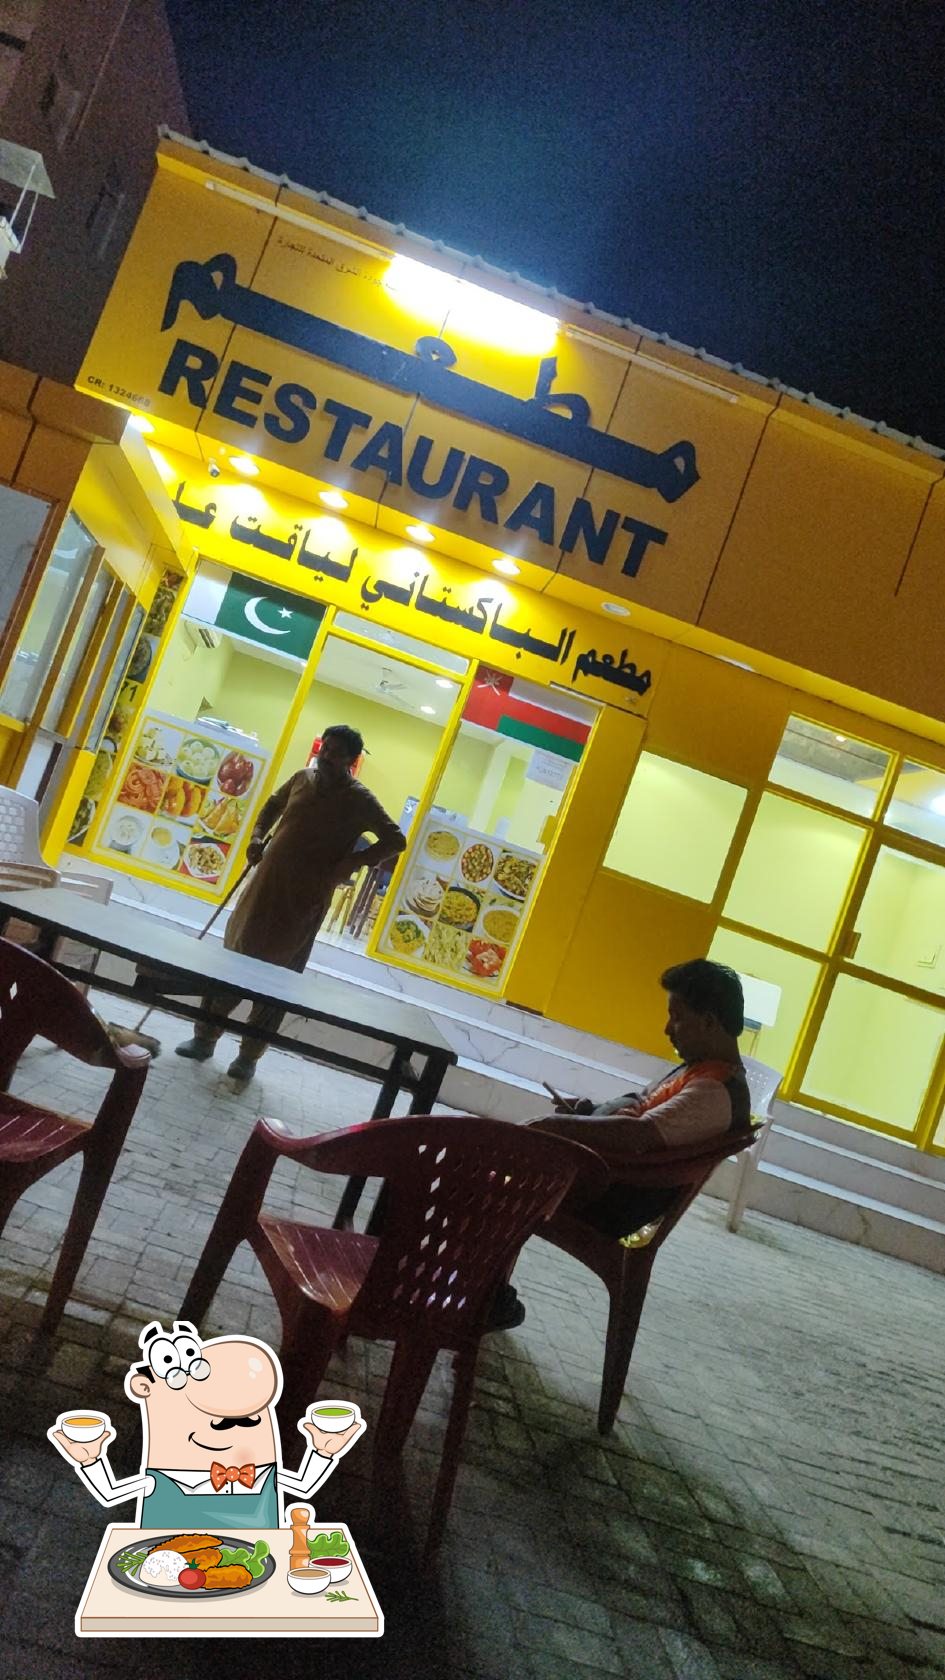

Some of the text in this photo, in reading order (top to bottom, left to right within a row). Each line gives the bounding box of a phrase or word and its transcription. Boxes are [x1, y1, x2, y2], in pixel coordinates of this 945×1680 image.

[160, 252, 701, 503] مطعم
[158, 338, 669, 578] RESTAURANT
[229, 515, 359, 582] لياقت
[360, 571, 576, 666] الباكستاني
[571, 648, 651, 696] مطعم
